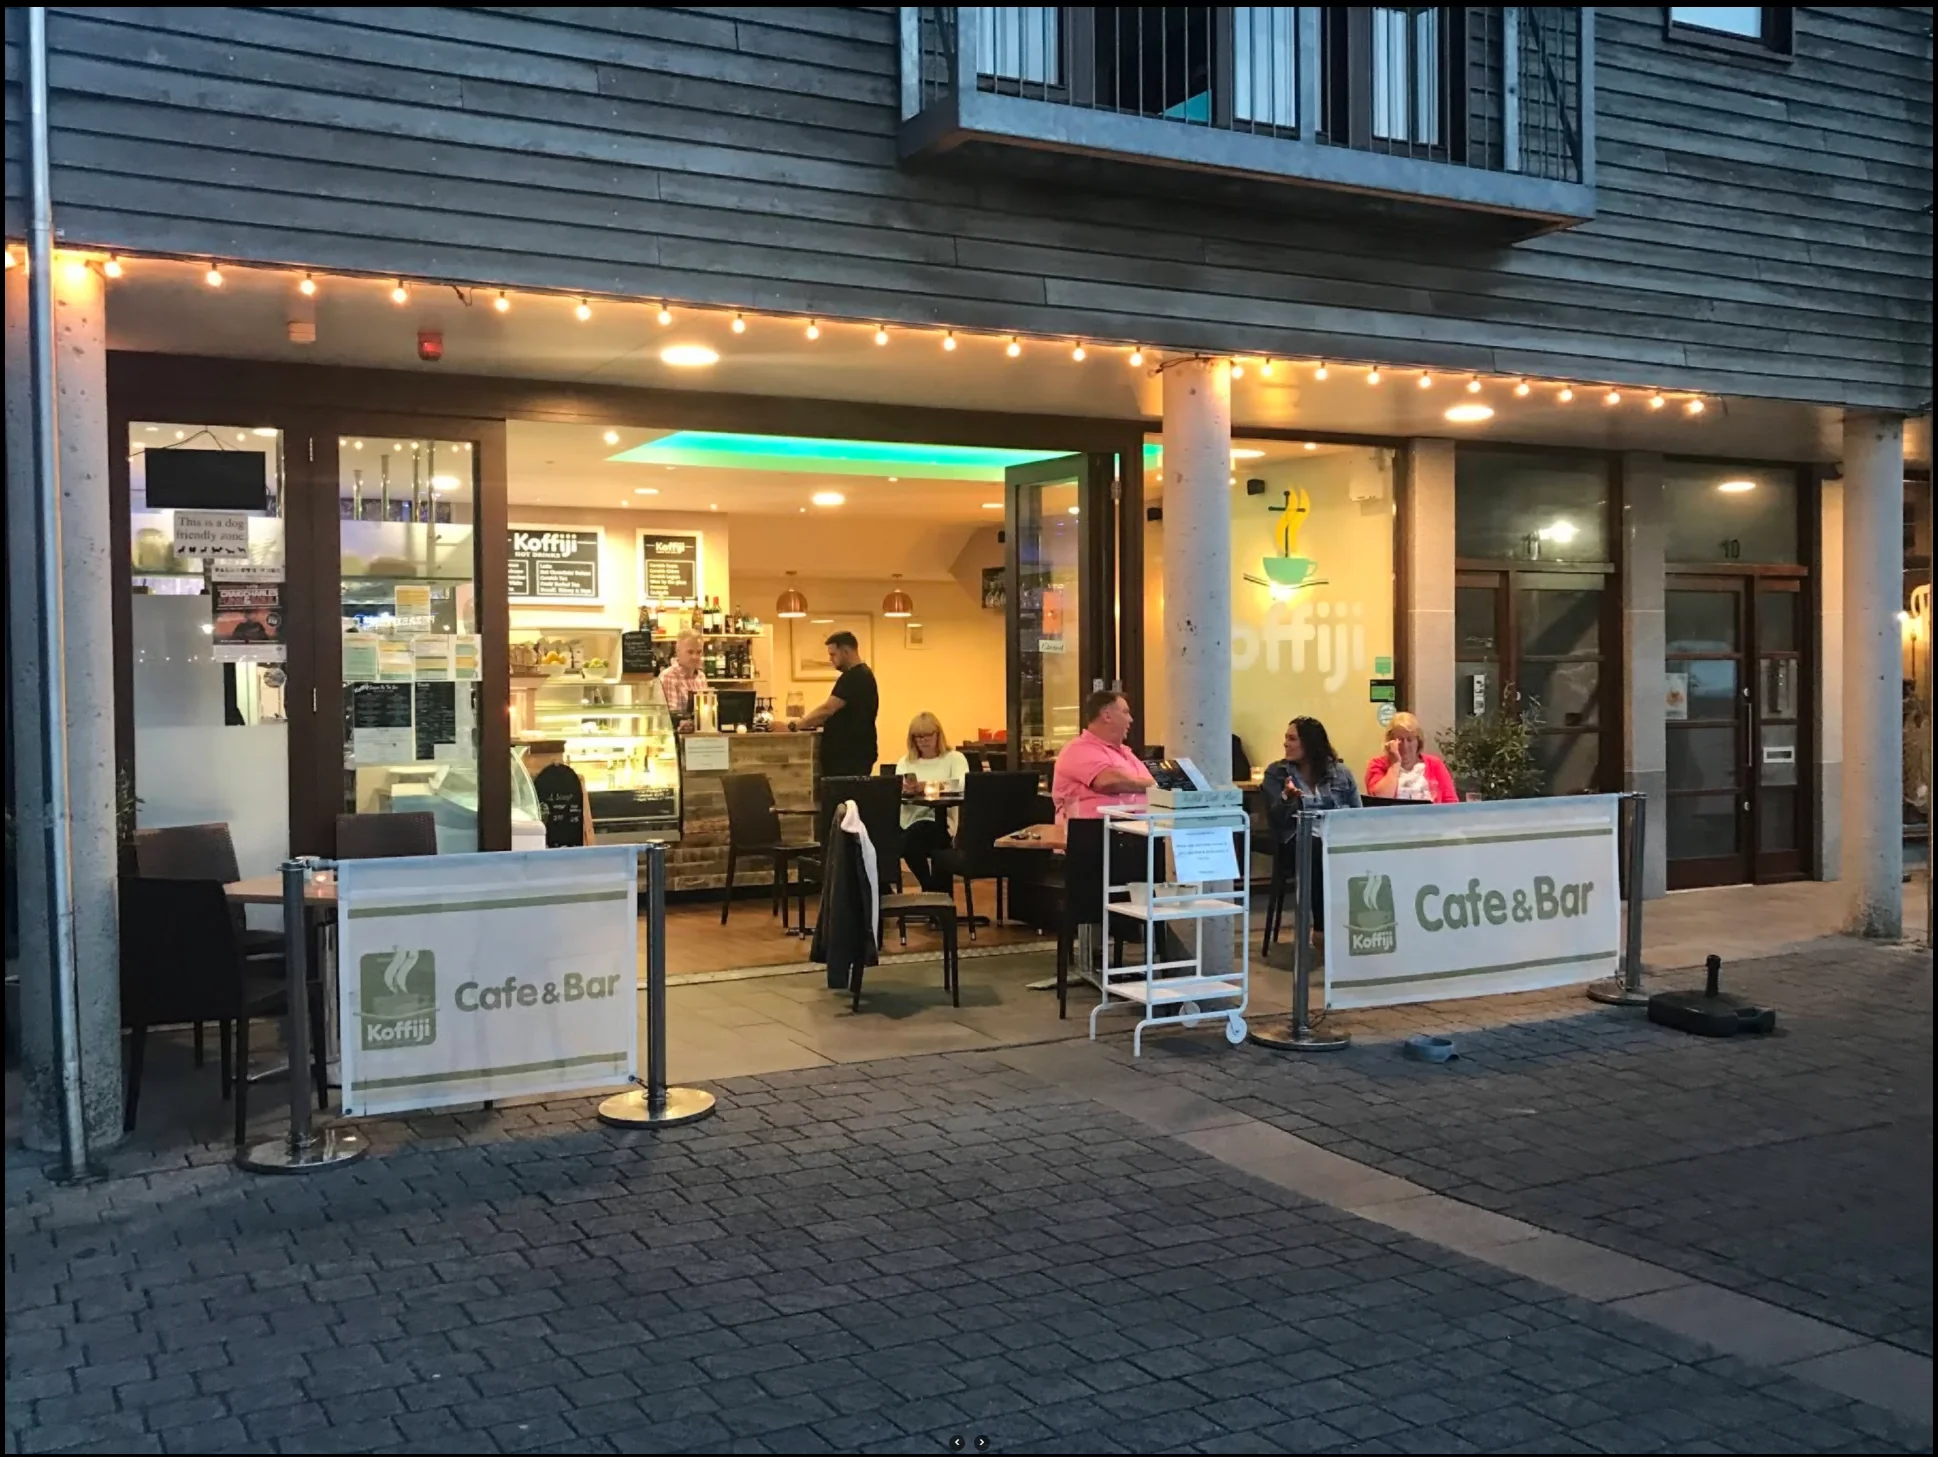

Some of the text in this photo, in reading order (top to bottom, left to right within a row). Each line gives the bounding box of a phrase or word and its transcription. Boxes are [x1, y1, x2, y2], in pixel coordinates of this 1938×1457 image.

[179, 516, 245, 531] This is a dog
[176, 528, 217, 542] friendly
[514, 532, 577, 558] Koffiji
[1718, 537, 1740, 559] 10
[1231, 601, 1365, 694] offiji
[1352, 931, 1394, 950] Koffiji
[367, 1018, 431, 1043] Koffiji
